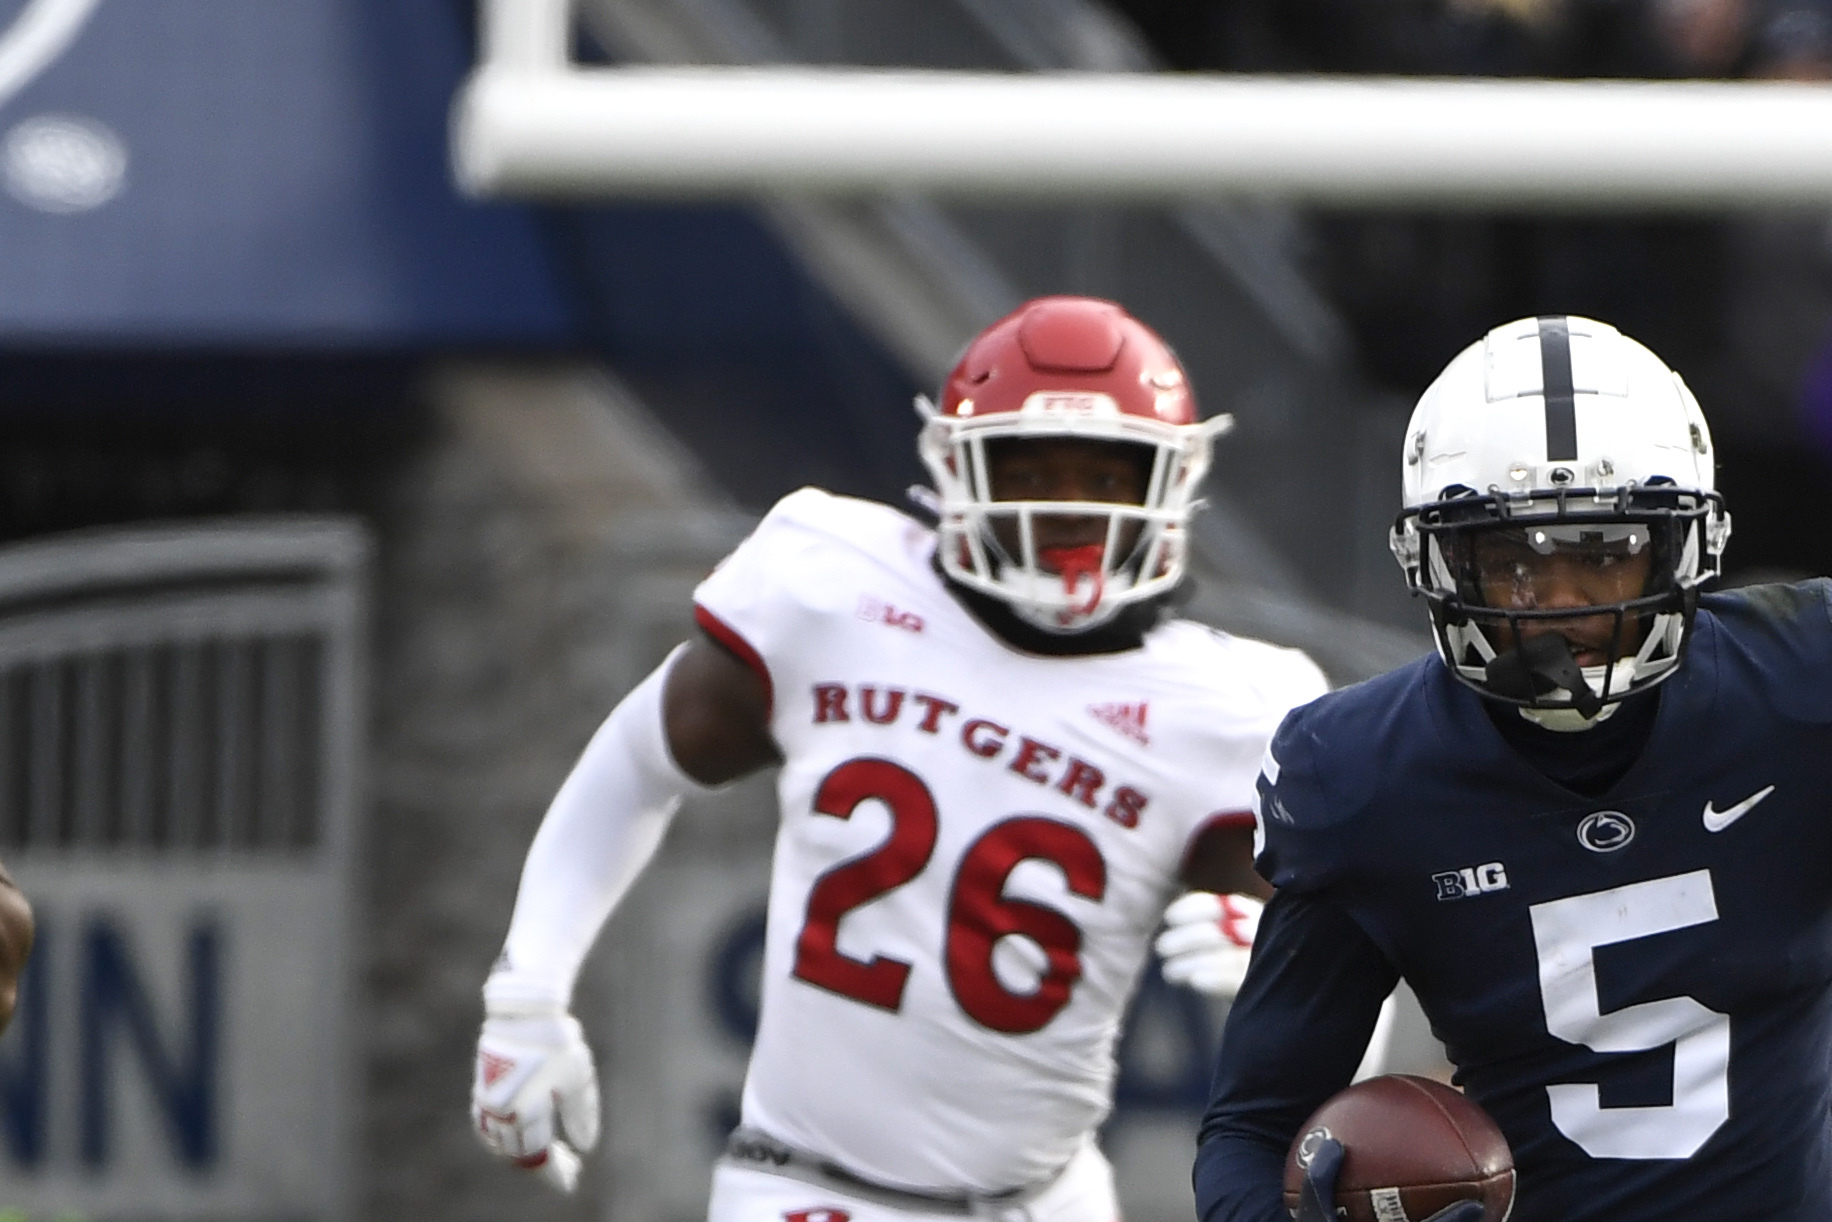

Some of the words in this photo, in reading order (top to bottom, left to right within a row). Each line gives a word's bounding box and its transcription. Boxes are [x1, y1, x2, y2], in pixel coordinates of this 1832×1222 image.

[791, 755, 1107, 1035] 26
[811, 681, 1151, 831] RUTGERS
[1528, 869, 1731, 1160] 5
